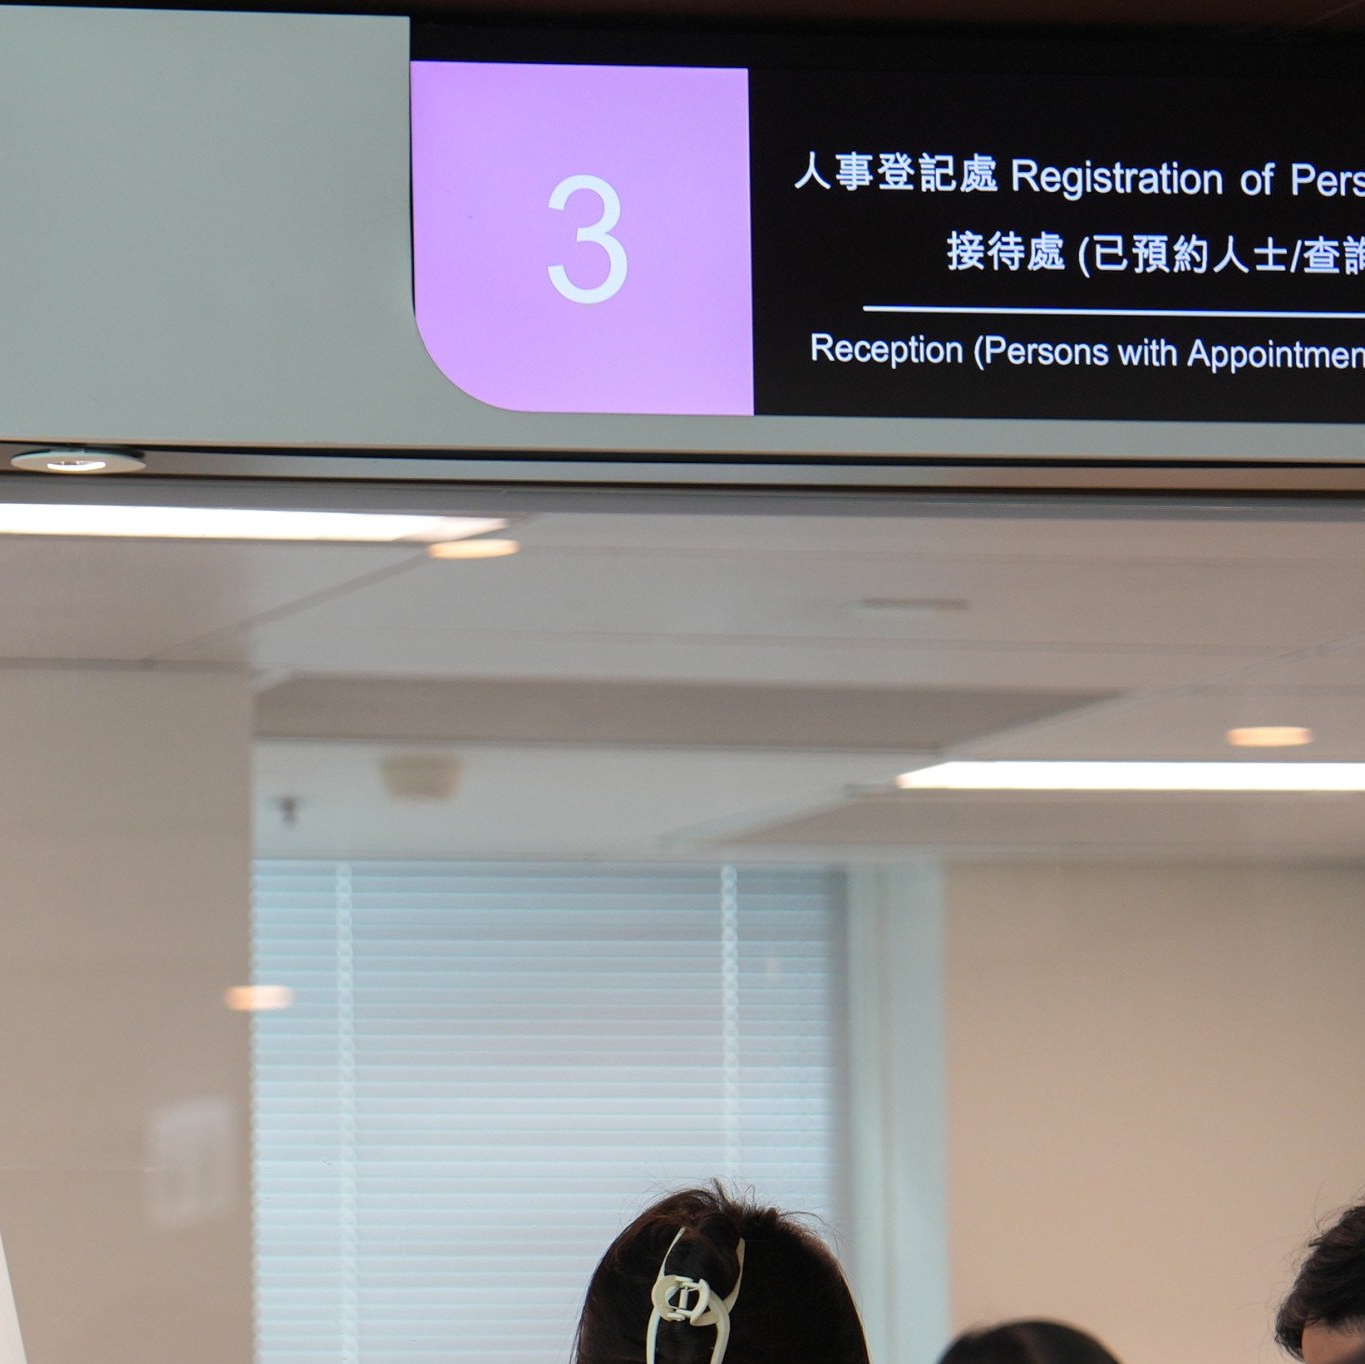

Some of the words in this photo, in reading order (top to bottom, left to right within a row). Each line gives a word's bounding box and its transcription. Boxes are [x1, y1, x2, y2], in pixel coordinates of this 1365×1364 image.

[794, 150, 999, 193] 人事登記處
[1012, 158, 1223, 201] Registration
[1240, 161, 1276, 196] of
[1291, 162, 1365, 198] Pers
[547, 174, 628, 304] 3
[946, 229, 1066, 271] 接待處
[811, 332, 963, 370] Reception
[973, 334, 1110, 371] (Persons
[1117, 337, 1178, 367] with
[1186, 338, 1365, 375] Appointmen
